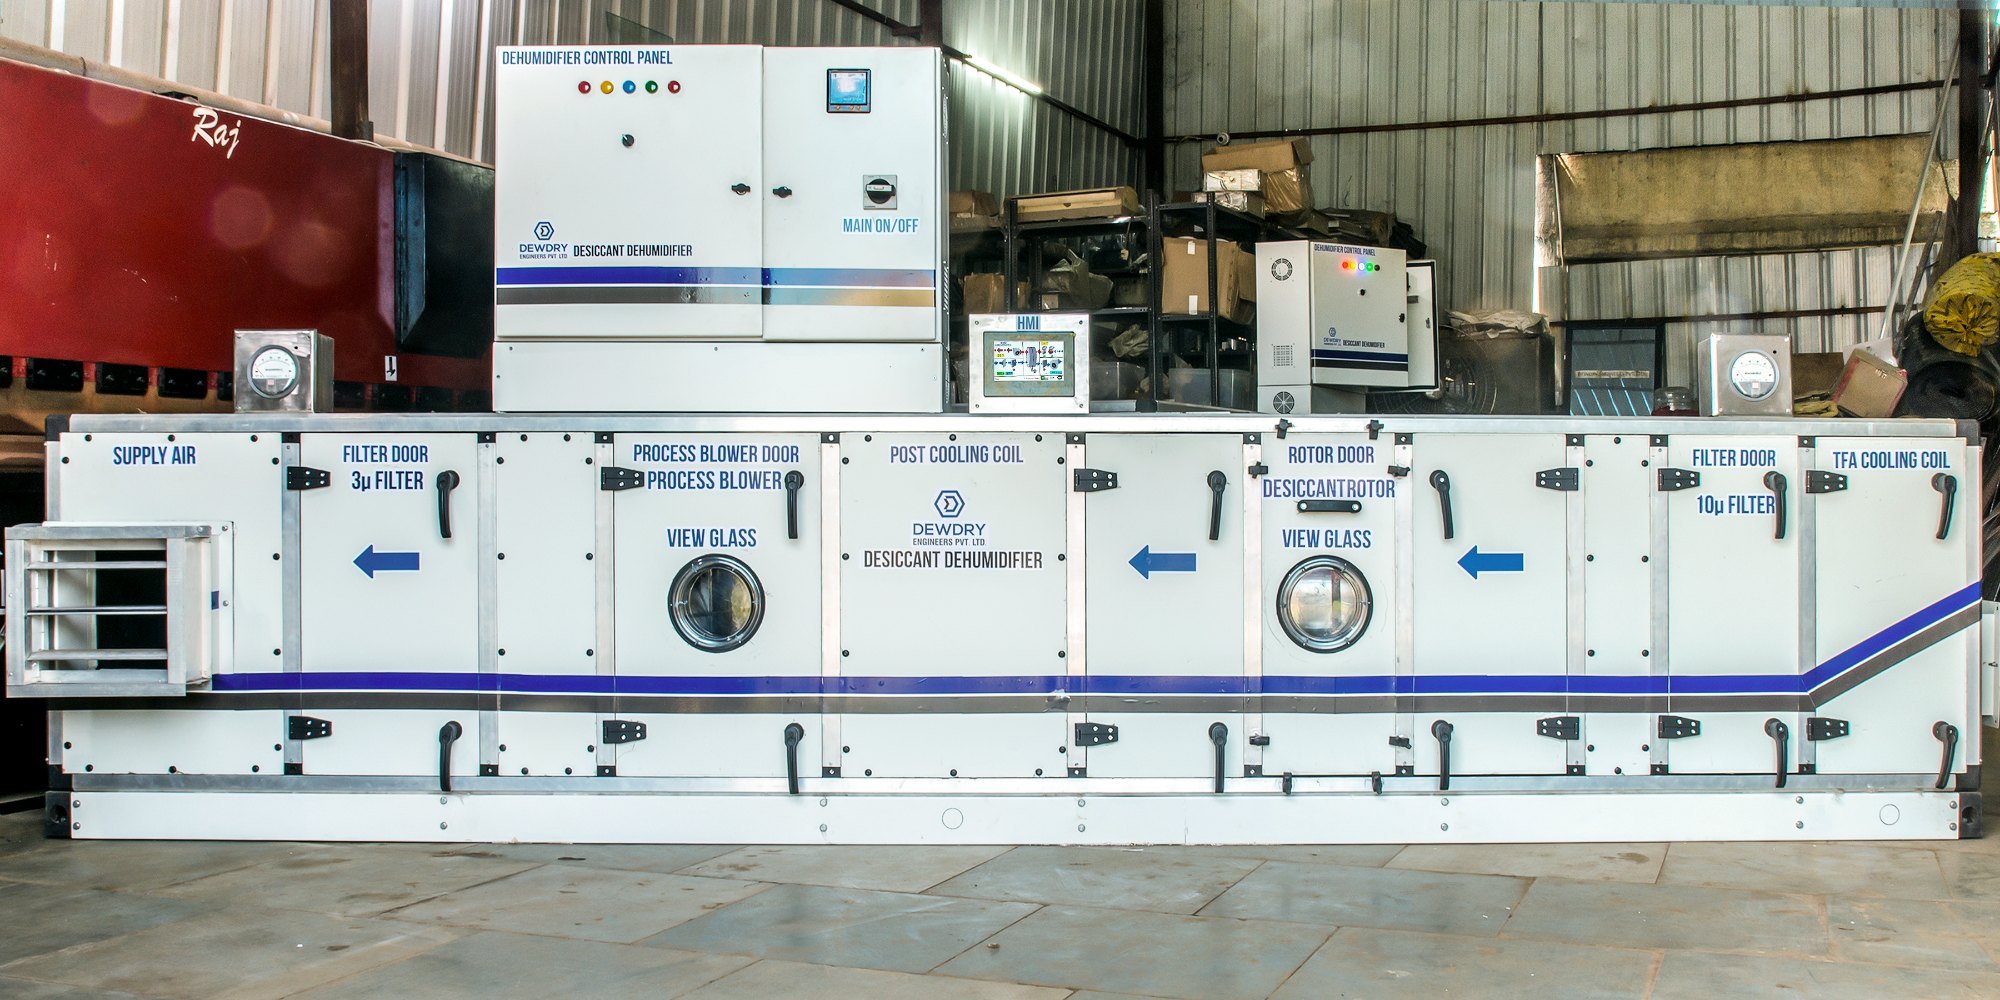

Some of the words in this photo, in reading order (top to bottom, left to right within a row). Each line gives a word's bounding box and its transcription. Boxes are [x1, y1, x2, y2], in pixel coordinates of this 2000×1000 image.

[502, 51, 581, 65] DEHUMIDIFIER
[584, 50, 634, 65] CONTROL
[637, 51, 673, 65] PANEL
[191, 107, 241, 159] Raj
[843, 218, 872, 233] MAIN
[875, 218, 919, 233] ON/OFF
[519, 243, 568, 253] DEWDRY
[573, 245, 624, 257] DESICCANT
[627, 245, 693, 257] DEHUMIDIFIER
[1017, 316, 1039, 330] HMI
[113, 446, 168, 465] SUPPLY
[171, 446, 196, 465] AIR
[343, 445, 388, 463] FILTER
[391, 445, 428, 463] DOOR
[633, 444, 696, 462] PROCESS
[700, 445, 758, 463] BLOWER
[762, 445, 799, 463] DOOR
[890, 445, 926, 463] POST
[929, 445, 989, 463] COOLING
[993, 445, 1024, 463] COIL
[1289, 446, 1333, 463] ROTOR
[1337, 446, 1374, 463] DOOR
[1692, 449, 1736, 466] FILTER
[1740, 449, 1776, 467] DOOR
[1832, 451, 1858, 469] TFA
[1861, 451, 1917, 469] COOLING
[1921, 451, 1951, 469] COIL
[352, 470, 371, 492] 3µ
[375, 470, 424, 490] FILTER
[647, 471, 715, 490] PROCESS
[719, 471, 782, 490] BLOWER
[1697, 494, 1724, 516] 10µ
[1728, 495, 1775, 514] FILTER
[667, 528, 705, 548] VIEW
[709, 528, 757, 548] GLASS
[913, 523, 986, 536] DEWDRY
[912, 538, 953, 546] ENGINEERS
[1282, 529, 1320, 548] VIEW
[1324, 529, 1372, 549] GLASS
[864, 550, 941, 568] DESICCANT
[944, 550, 1043, 569] DEHUMIDIFIER
